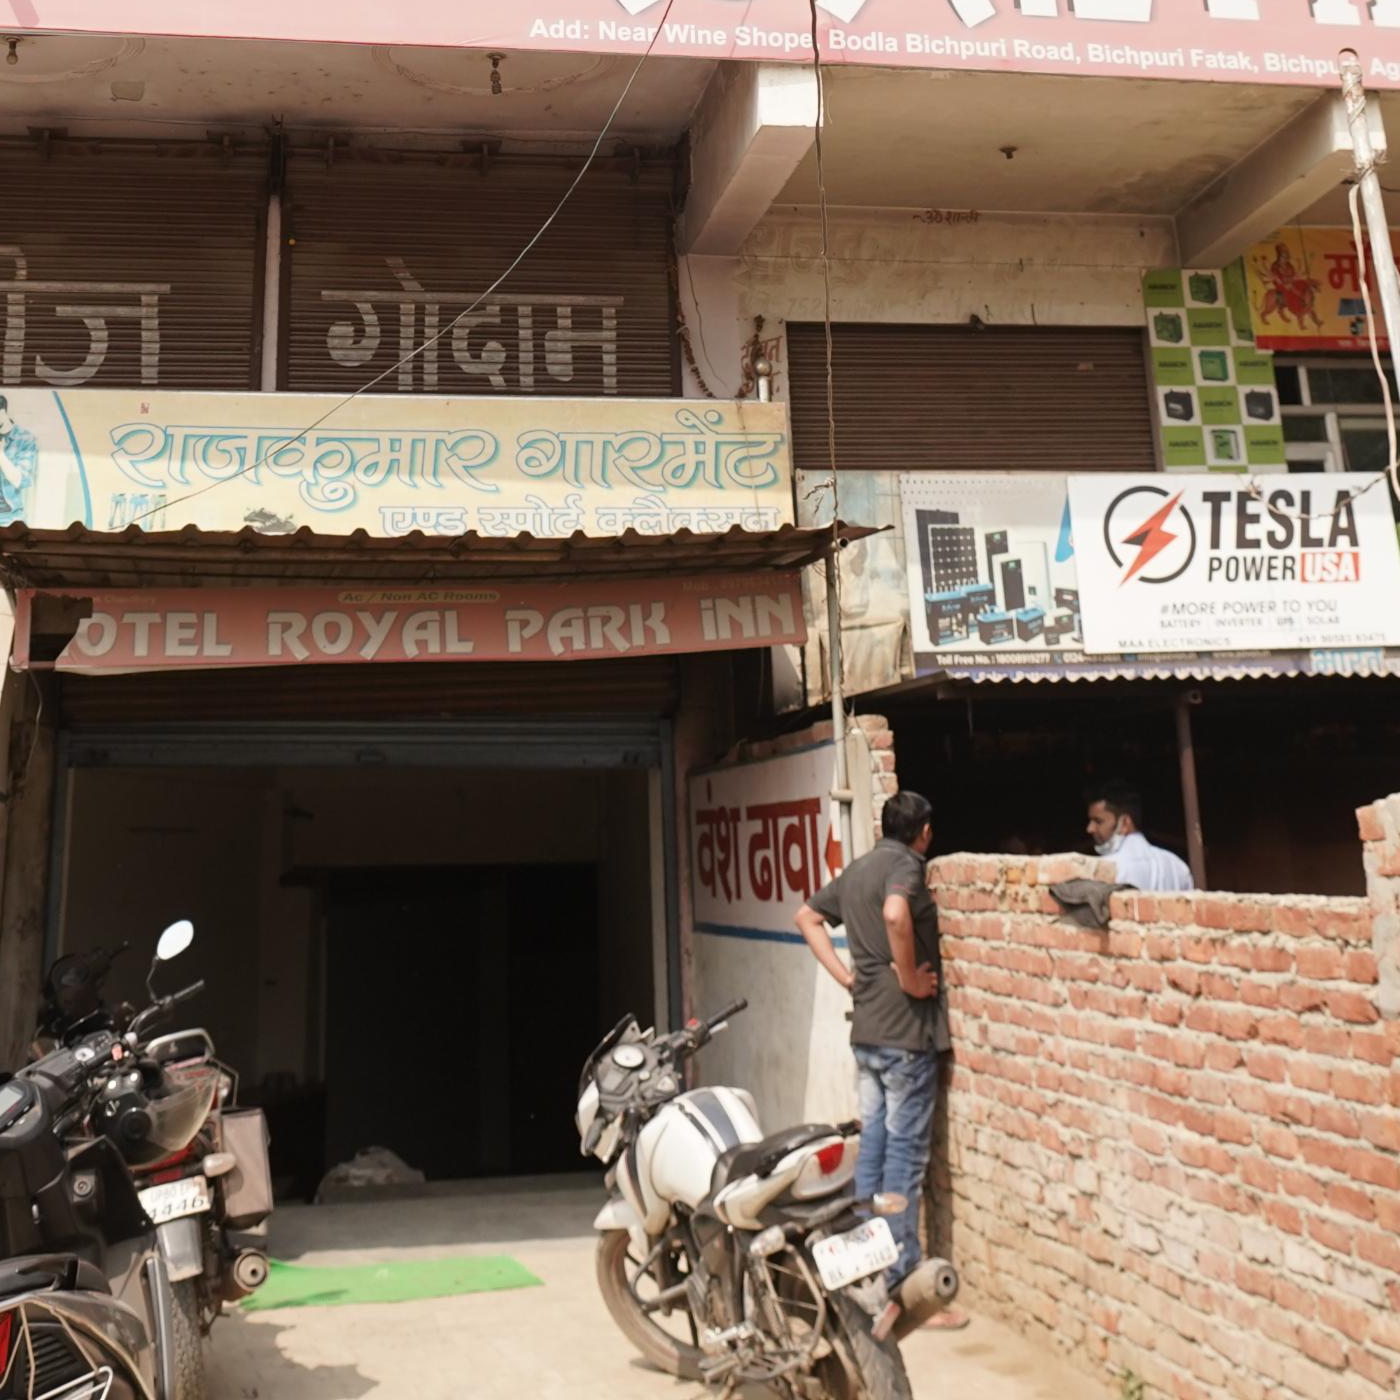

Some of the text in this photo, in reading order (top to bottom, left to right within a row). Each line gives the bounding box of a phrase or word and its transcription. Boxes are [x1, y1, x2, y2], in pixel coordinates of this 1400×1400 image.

[530, 18, 590, 40] Add:
[600, 21, 656, 42] Near
[663, 24, 727, 46] Wine
[829, 29, 898, 52] Bodla
[906, 33, 1007, 61] Bichpuri
[1013, 40, 1080, 64] Road,
[1088, 44, 1184, 70] Bichpuri
[1190, 49, 1259, 73] Fatak,
[321, 257, 624, 393] गोदाम
[107, 408, 786, 511] राजकुमार गारमेंट
[378, 506, 468, 536] एण्ड
[476, 494, 585, 537] स्पोर्ट
[1202, 488, 1359, 550] TESLA
[381, 591, 413, 601] Non
[417, 591, 439, 601] AC
[443, 590, 497, 601] Rooms
[1208, 553, 1356, 583] POWER USA
[62, 609, 233, 658] OTEL
[266, 609, 474, 661] ROYAL
[504, 602, 672, 657] PARK
[1222, 600, 1277, 614] POWER
[1283, 600, 1302, 613] TO
[1306, 599, 1338, 613] YOU
